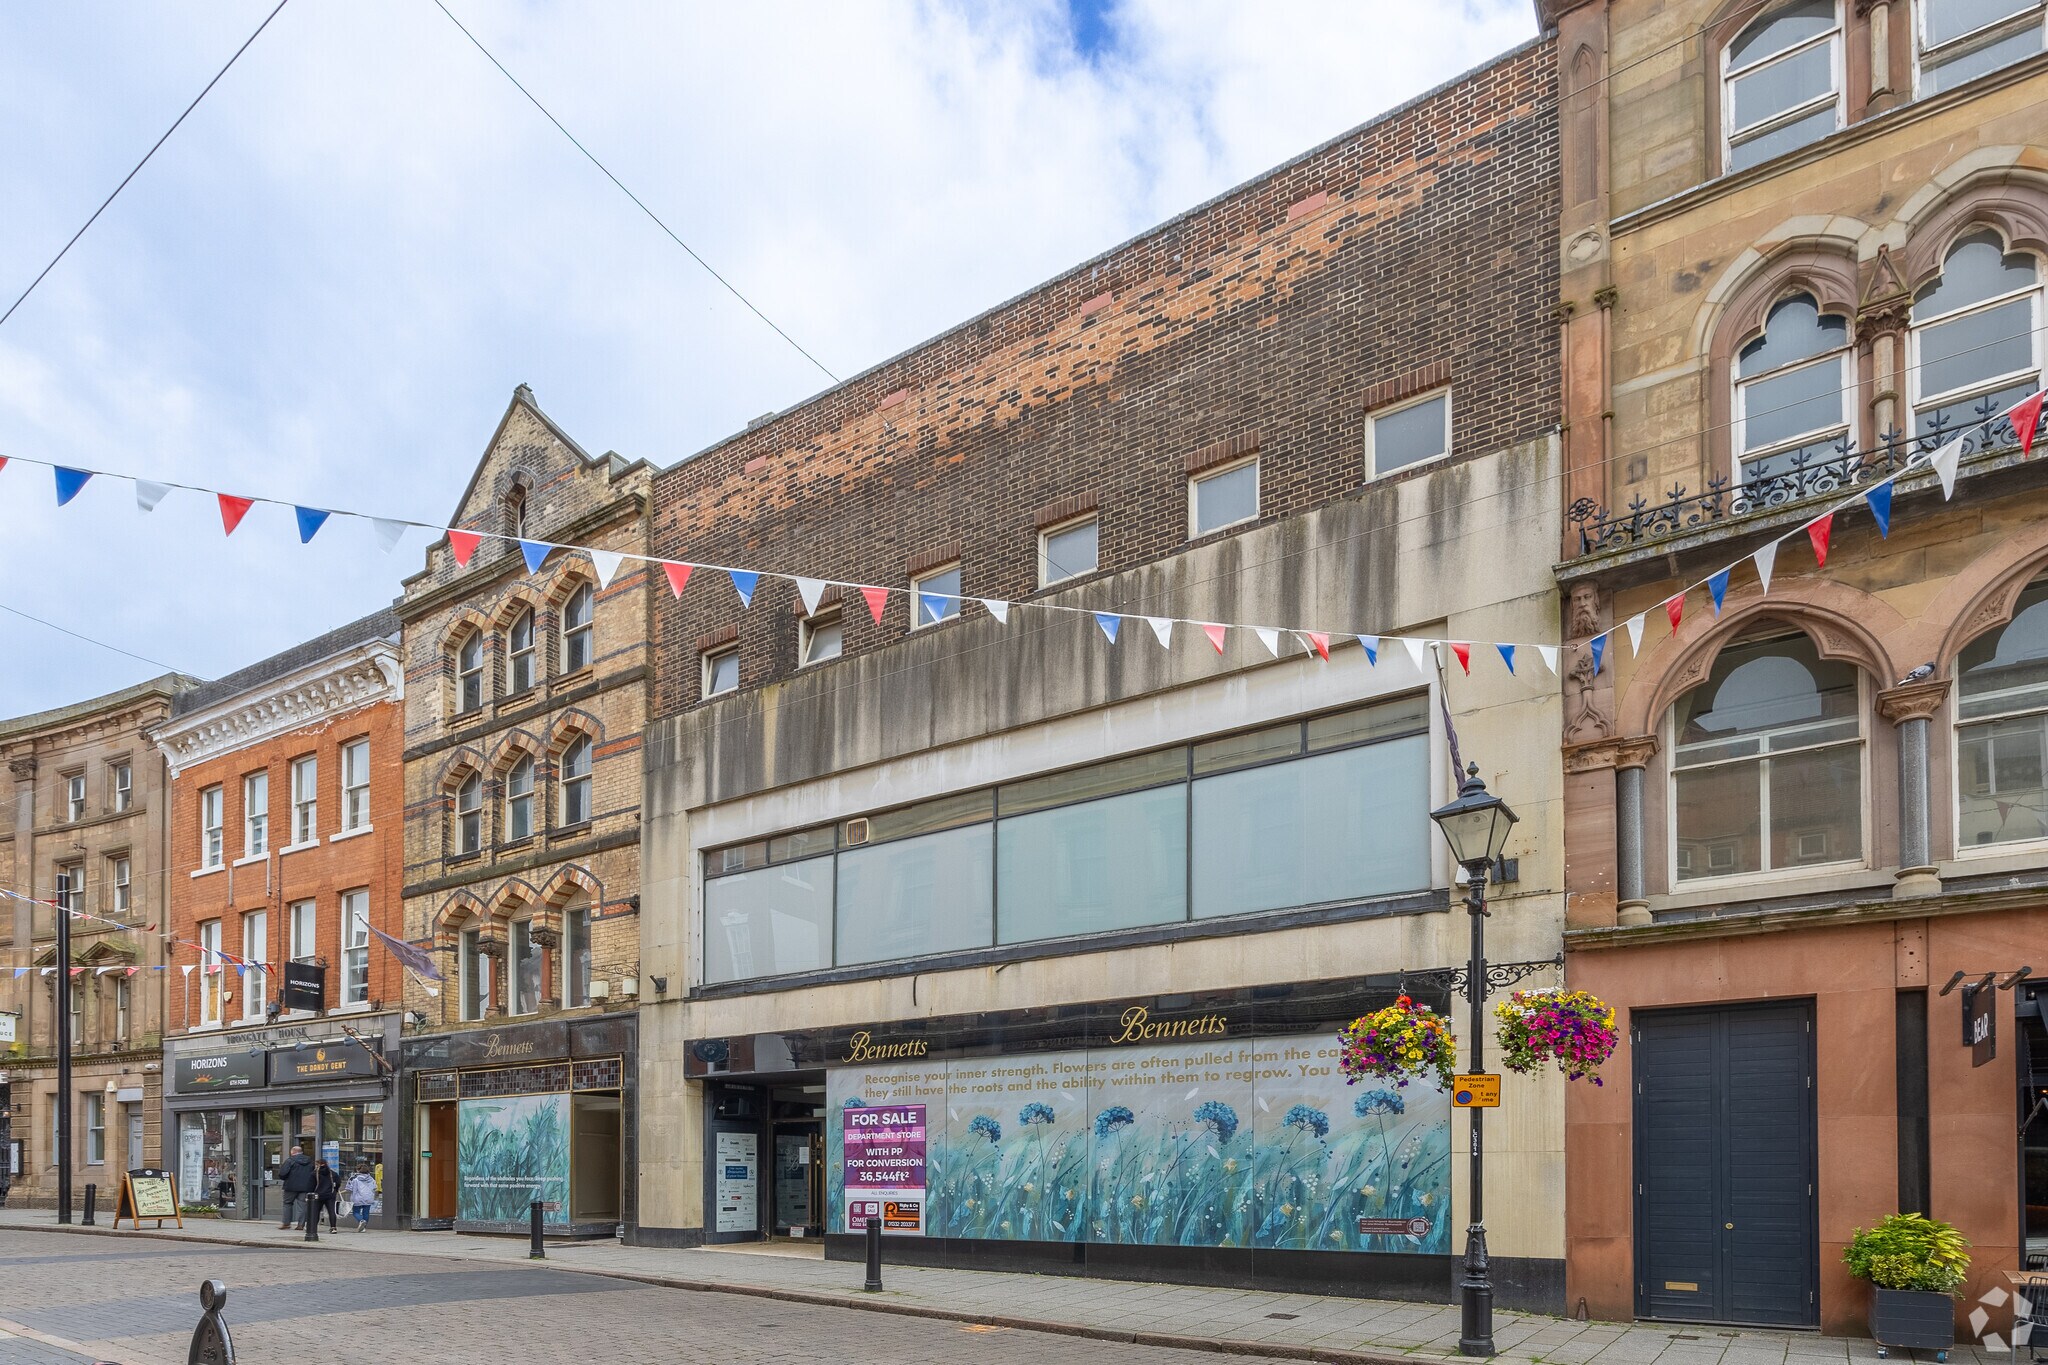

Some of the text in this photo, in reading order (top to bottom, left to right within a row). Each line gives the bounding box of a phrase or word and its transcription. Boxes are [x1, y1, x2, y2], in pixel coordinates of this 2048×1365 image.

[290, 980, 320, 988] HORIZONS
[1109, 1005, 1228, 1044] Bennetts
[1974, 1012, 1989, 1045] BEAR
[227, 1027, 307, 1045] IRONGATE HOUSE
[482, 1033, 534, 1059] Bennetts
[841, 1030, 928, 1063] Bennetts
[191, 1057, 228, 1070] HORIZONS
[296, 1061, 347, 1073] THE DANDY GENT
[865, 1071, 920, 1086] Recognise
[924, 1072, 952, 1084] your
[956, 1068, 987, 1079] inner
[991, 1063, 1048, 1079] strength.
[1053, 1061, 1107, 1074] Flowers
[1111, 1061, 1136, 1071] are
[1140, 1055, 1179, 1069] often
[1184, 1051, 1233, 1069] pulled
[1238, 1049, 1278, 1063] from
[1284, 1047, 1311, 1060] the
[865, 1087, 889, 1100] they
[892, 1085, 912, 1097] still
[915, 1085, 944, 1096] have
[948, 1083, 967, 1094] the
[971, 1082, 1004, 1093] roots
[1007, 1079, 1032, 1092] and
[1036, 1078, 1057, 1090] the
[1062, 1075, 1106, 1090] ability
[1111, 1072, 1156, 1086] within
[1161, 1071, 1199, 1084] them
[1204, 1071, 1220, 1082] to
[1225, 1069, 1292, 1083] regrow.
[1298, 1064, 1331, 1077] You
[851, 1111, 917, 1126] FOR SALE
[847, 1131, 922, 1141] DEPARTMENT STORE
[866, 1147, 903, 1156] WITH PP
[847, 1158, 923, 1168] FOR CONVERSION
